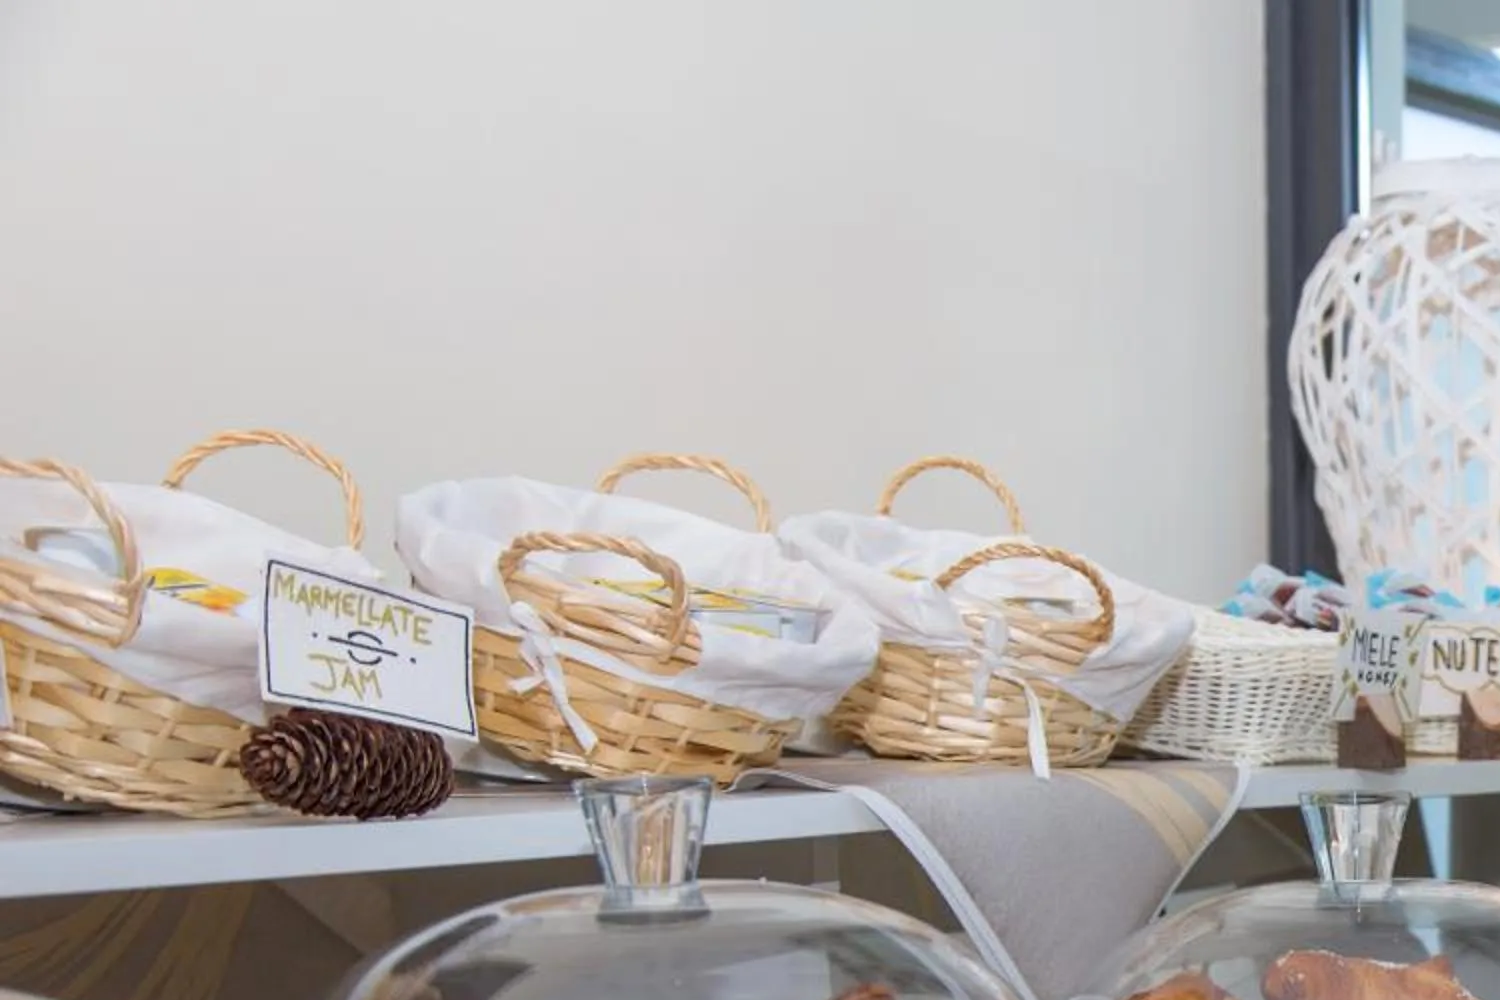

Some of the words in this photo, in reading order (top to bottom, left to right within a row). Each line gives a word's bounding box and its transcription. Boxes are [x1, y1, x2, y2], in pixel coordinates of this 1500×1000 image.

[273, 570, 433, 645] MARMELLATE
[1352, 627, 1400, 668] MIELE
[307, 653, 382, 701] JAM
